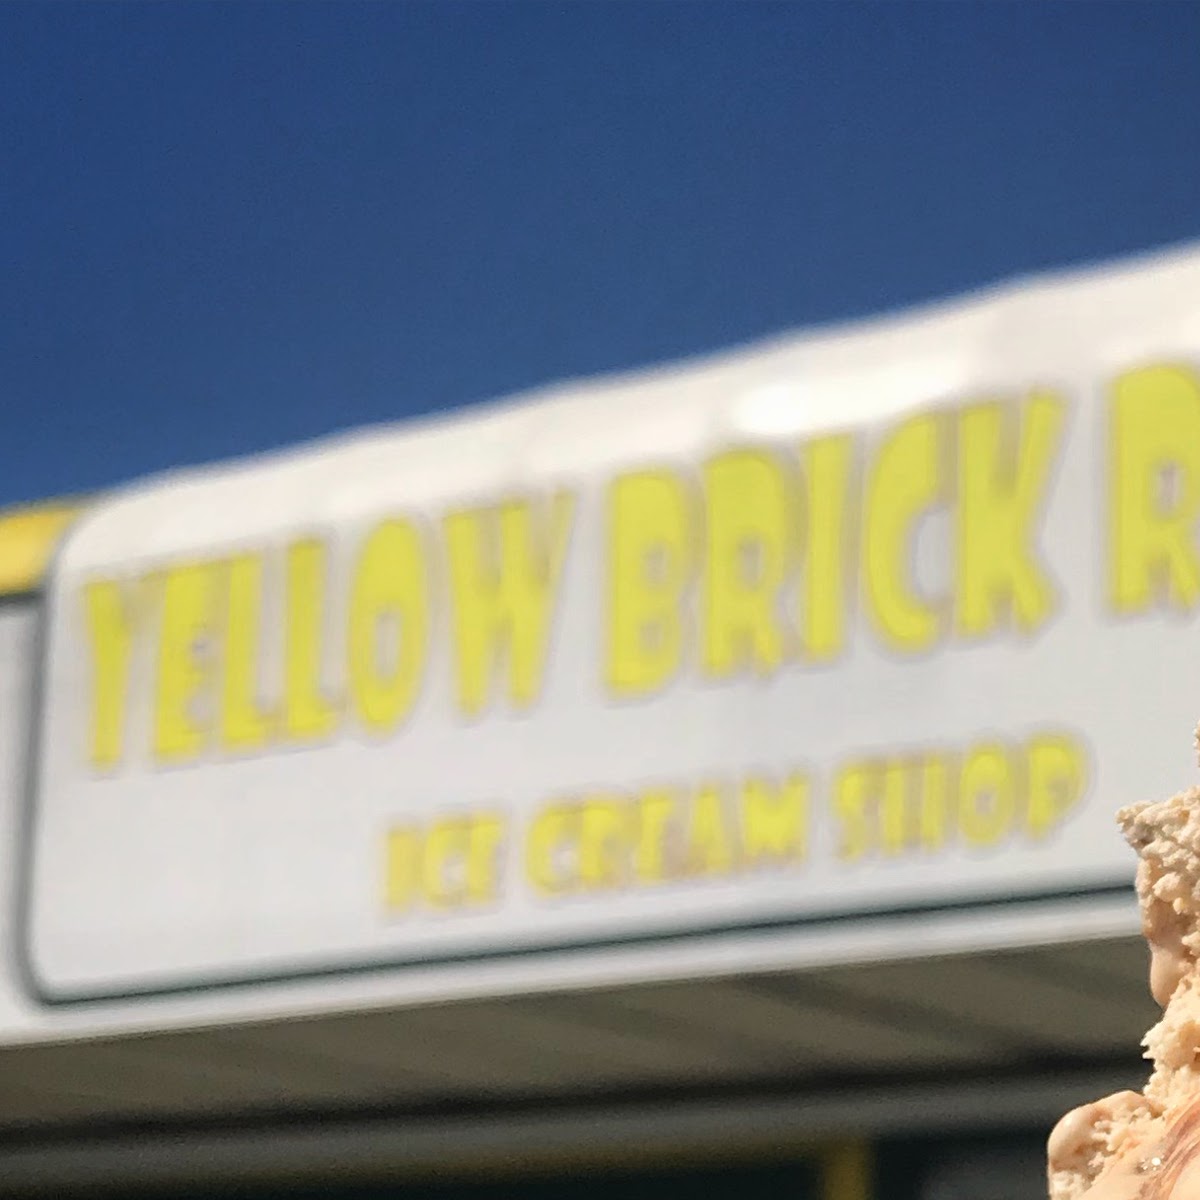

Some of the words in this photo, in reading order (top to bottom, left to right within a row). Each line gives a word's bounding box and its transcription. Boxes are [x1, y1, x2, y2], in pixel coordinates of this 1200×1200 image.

[78, 488, 576, 775] YELLOW
[605, 388, 1066, 698] BRICK
[382, 812, 504, 912] ICE
[524, 772, 810, 894] CREAM
[832, 733, 1087, 862] SHOP
